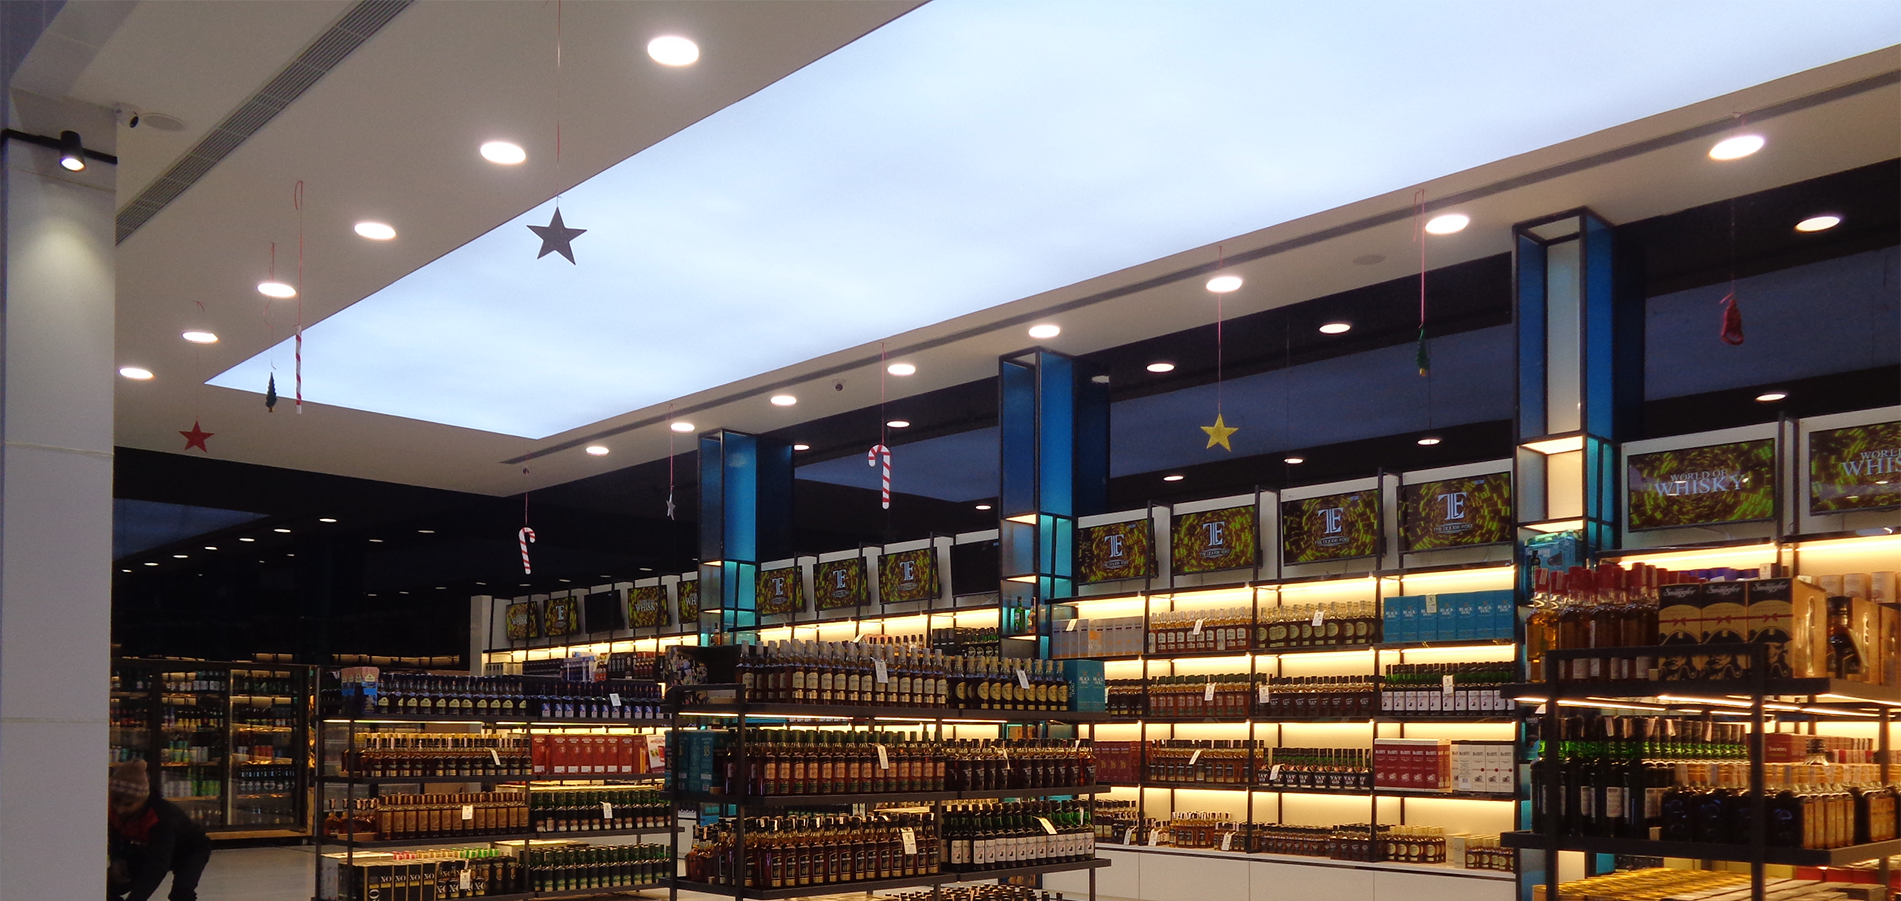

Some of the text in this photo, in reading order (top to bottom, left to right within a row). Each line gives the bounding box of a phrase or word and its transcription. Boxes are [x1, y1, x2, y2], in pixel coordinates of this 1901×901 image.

[1670, 469, 1728, 482] WORLD OF
[1654, 474, 1746, 497] WHISKY
